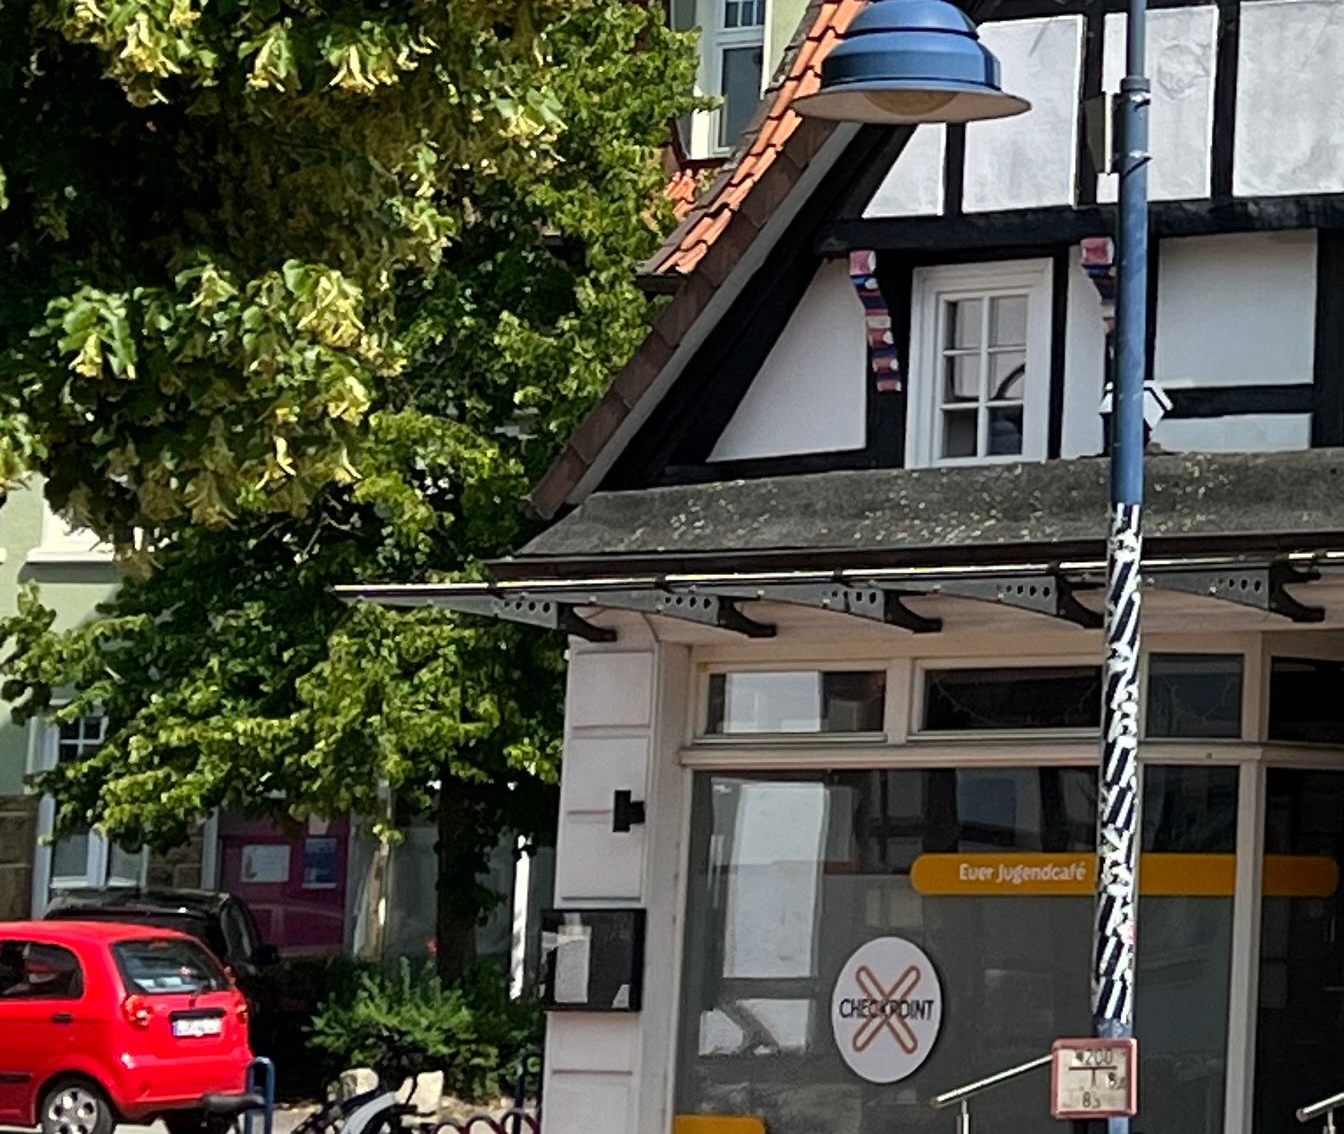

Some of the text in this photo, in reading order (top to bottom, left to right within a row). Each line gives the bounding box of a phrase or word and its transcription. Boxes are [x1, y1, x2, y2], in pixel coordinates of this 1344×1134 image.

[959, 861, 1086, 885] Euer Jugendcafé
[840, 998, 935, 1021] CHECKPOINT
